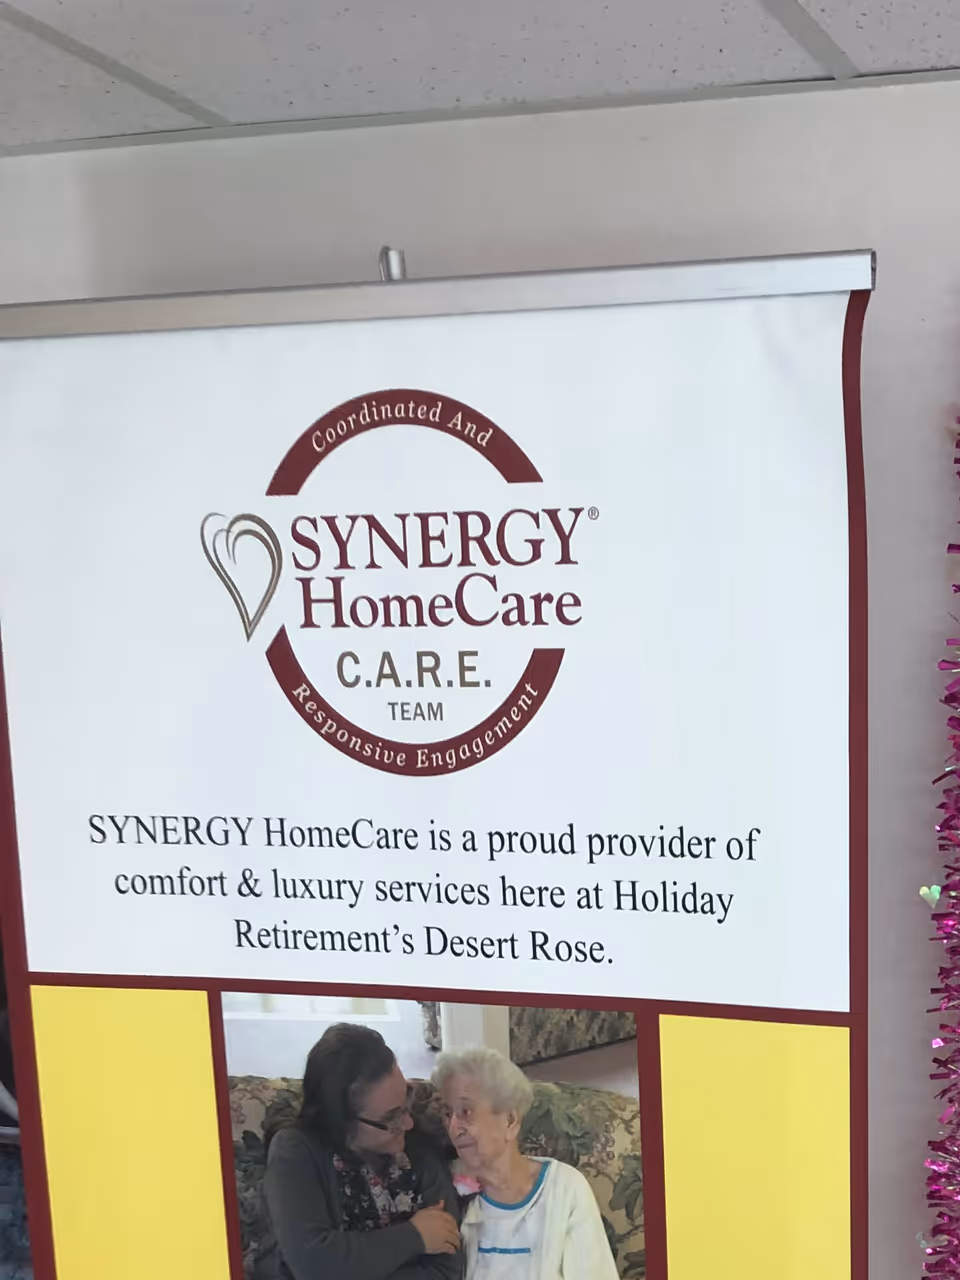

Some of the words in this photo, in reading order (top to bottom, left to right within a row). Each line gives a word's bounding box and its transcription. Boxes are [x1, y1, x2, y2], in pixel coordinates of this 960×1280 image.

[310, 400, 442, 453] Coordinated
[447, 412, 494, 448] And
[295, 572, 583, 629] HomeCare
[336, 649, 492, 688] C.A.R.E.
[291, 682, 407, 767] Responsive
[415, 682, 539, 769] Engagement
[387, 701, 444, 721] TEAM
[88, 814, 254, 846] SYNERGY
[264, 817, 419, 850] HomeCare
[429, 819, 451, 851] is
[461, 829, 478, 852] a
[488, 823, 577, 861] proud
[586, 825, 716, 864] provider
[726, 827, 761, 861] of
[114, 866, 228, 898] comfort
[237, 868, 263, 898] &
[272, 869, 364, 908] luxury
[375, 873, 490, 906] services
[499, 875, 566, 908] here
[576, 881, 604, 910] at
[612, 880, 735, 924] Holiday
[233, 918, 415, 955] Retirement's
[423, 926, 519, 960] Desert
[528, 930, 613, 964] Rose.
